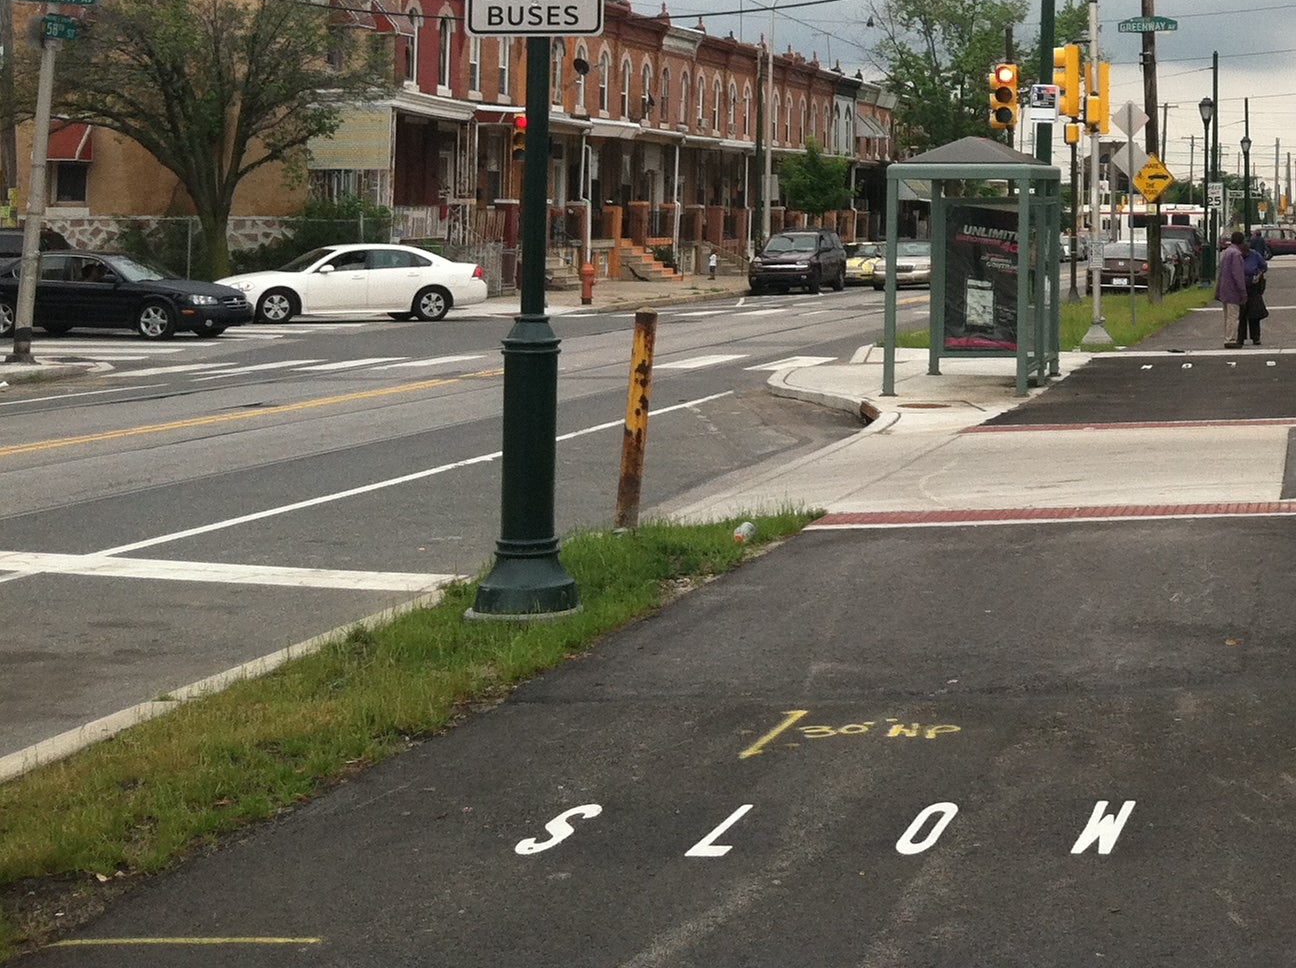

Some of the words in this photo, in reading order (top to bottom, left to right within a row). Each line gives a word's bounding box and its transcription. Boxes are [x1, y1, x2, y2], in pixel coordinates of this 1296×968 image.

[487, 6, 579, 26] BUSES
[1120, 22, 1166, 31] GREENWAY
[1207, 196, 1221, 206] 25
[514, 800, 1136, 857] SLOW
